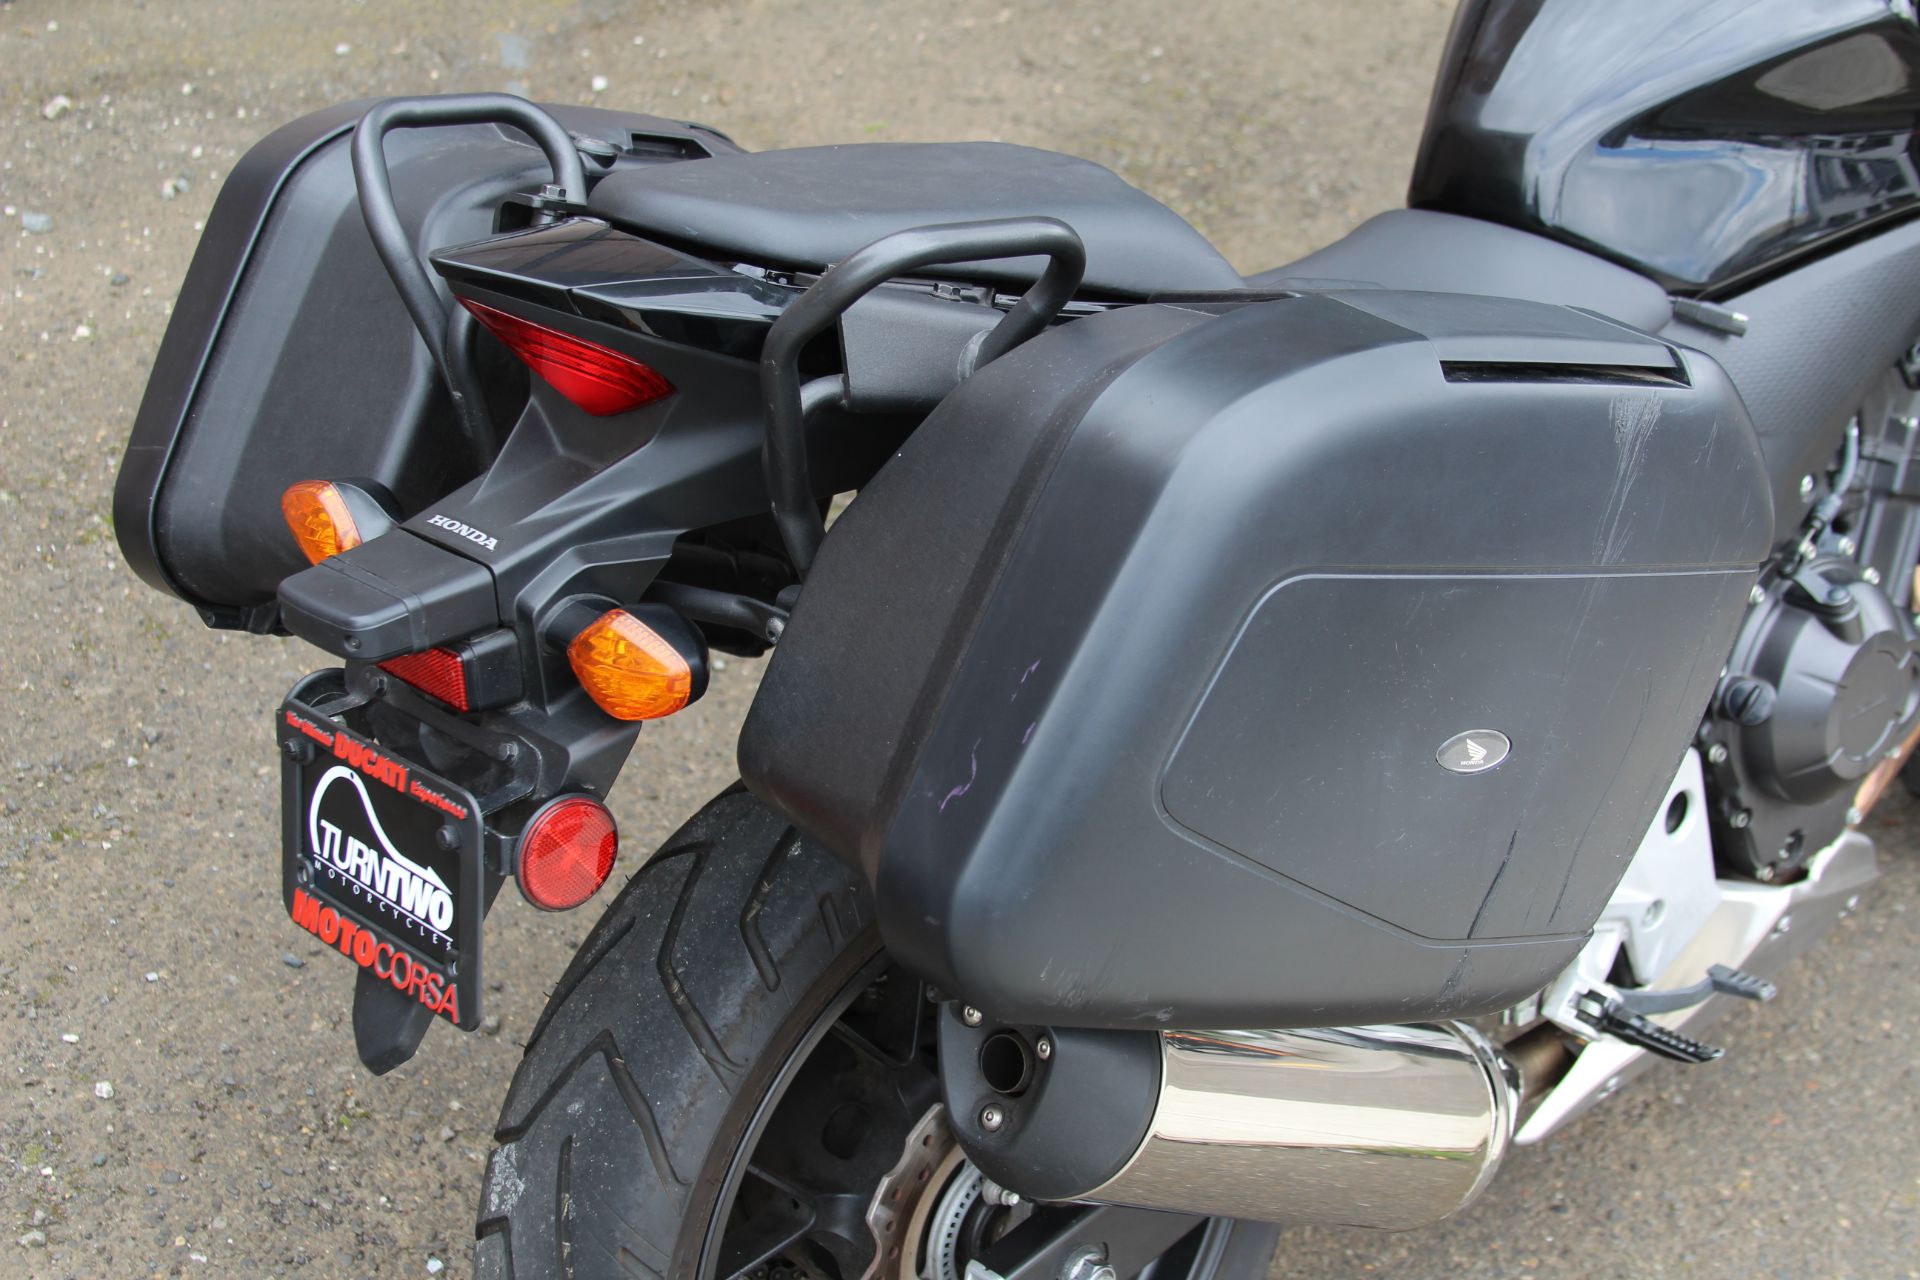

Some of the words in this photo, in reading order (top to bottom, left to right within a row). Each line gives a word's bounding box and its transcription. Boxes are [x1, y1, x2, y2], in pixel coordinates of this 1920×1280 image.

[426, 514, 498, 551] HONDA
[333, 731, 410, 793] DUCATI
[314, 859, 453, 951] MOTORCYCLES
[320, 818, 454, 931] TURNTWO
[292, 887, 461, 1024] MOTOCORSA
